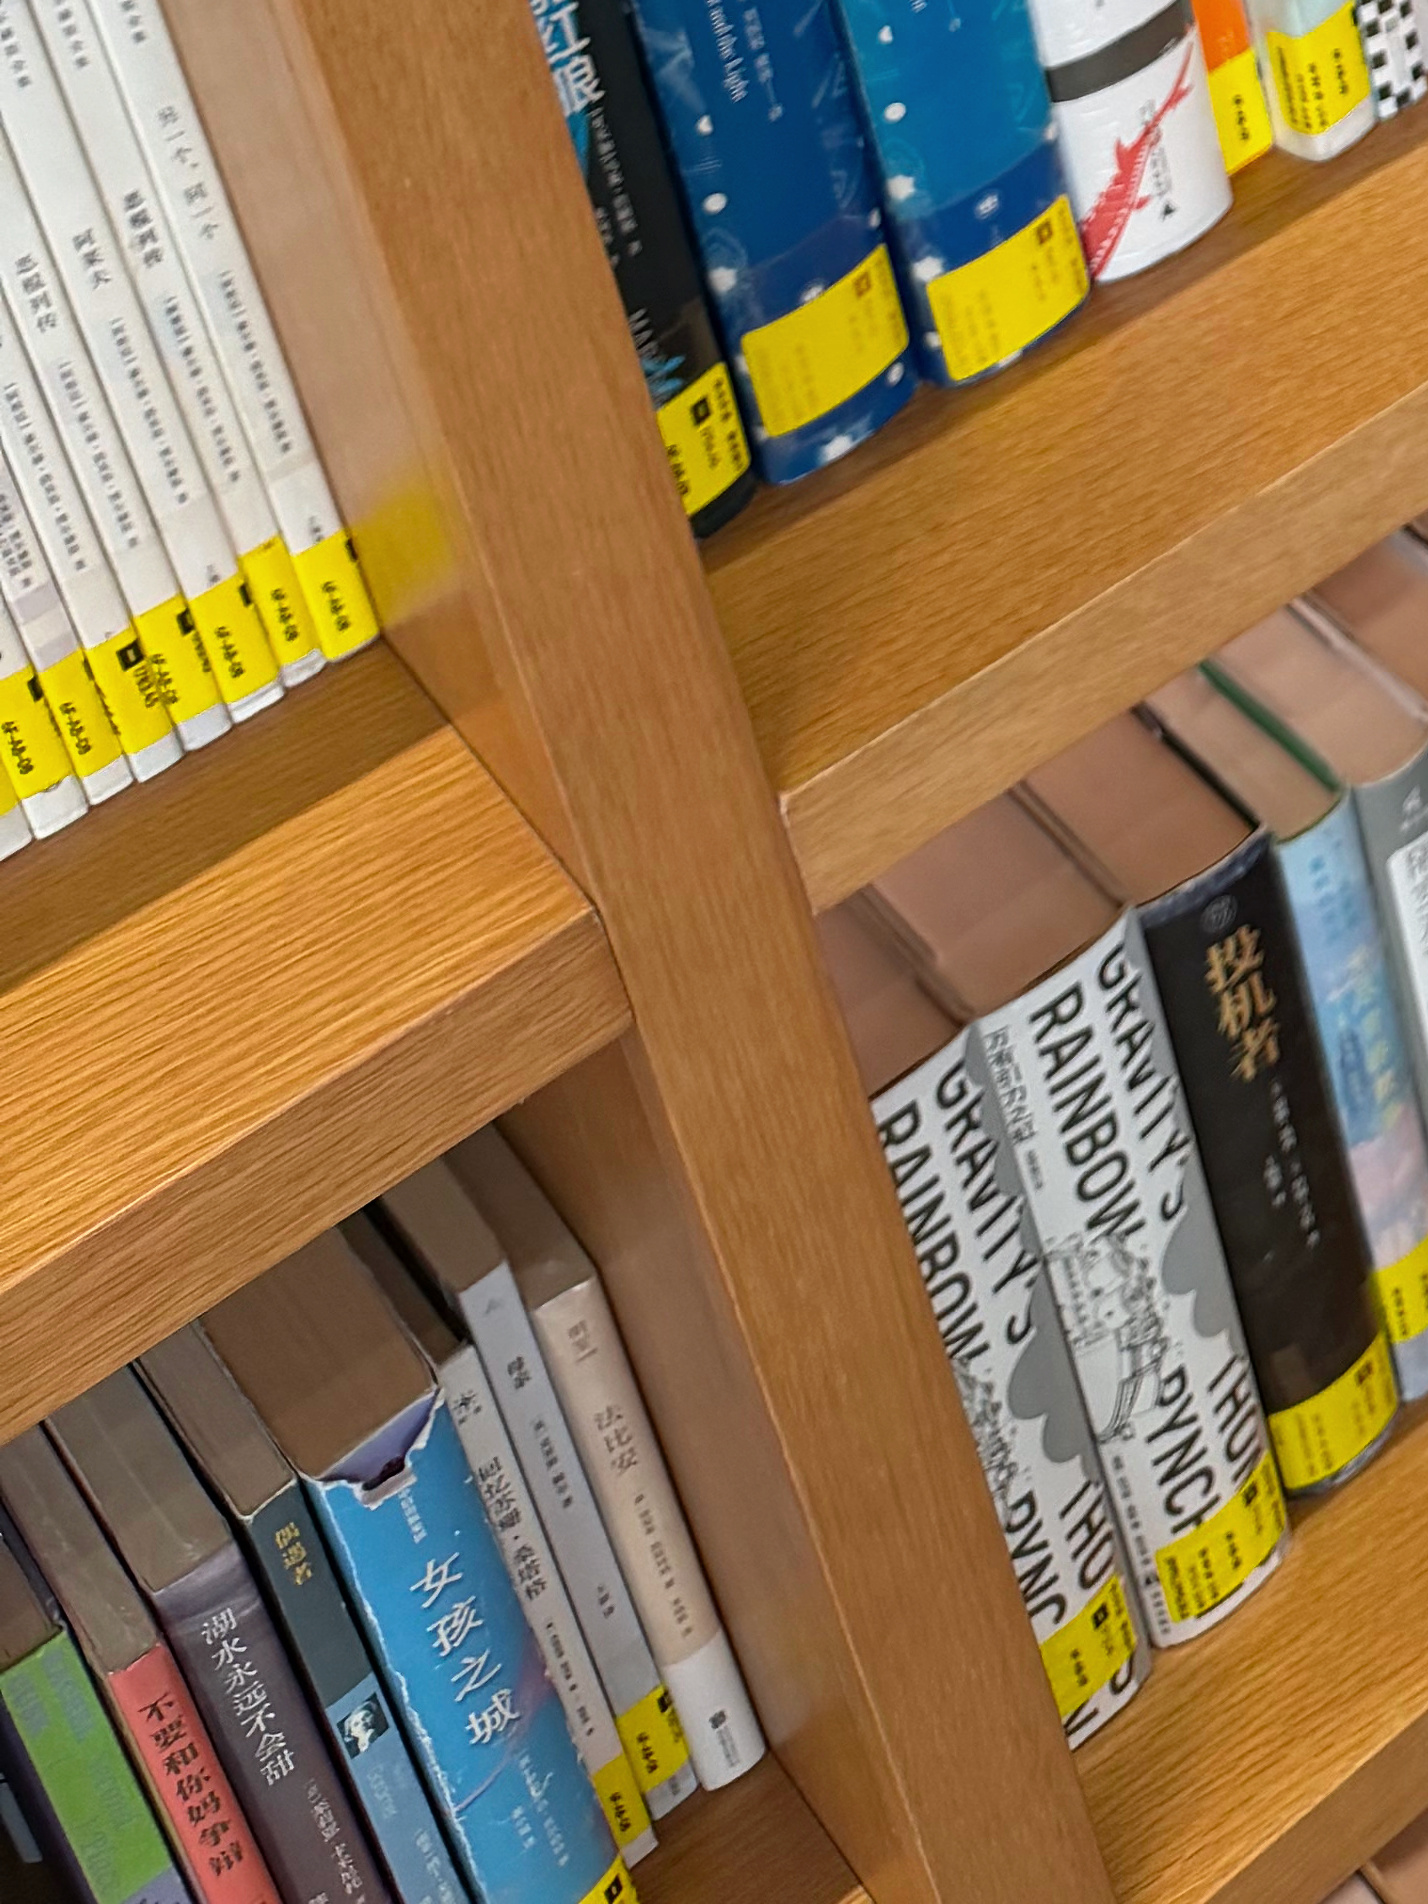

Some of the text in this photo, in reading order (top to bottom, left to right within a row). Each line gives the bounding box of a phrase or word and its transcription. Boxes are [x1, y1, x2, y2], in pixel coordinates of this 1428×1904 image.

[1095, 942, 1193, 1223] GRAVITY'S
[1203, 924, 1280, 1084] 投机者
[1028, 981, 1148, 1243] RAINBOW
[876, 1098, 990, 1365] RAINBOW
[934, 1061, 1040, 1348] GRAVITY'S
[593, 1401, 640, 1478] 法比安
[1145, 1363, 1221, 1535] PYNC
[1207, 1354, 1265, 1493] THO
[273, 1521, 314, 1587] 偶遇者
[199, 1606, 297, 1787] 湖水永远不会甜
[408, 1551, 523, 1748] 女孩之城
[136, 1691, 244, 1878] 不要和你妈争辩
